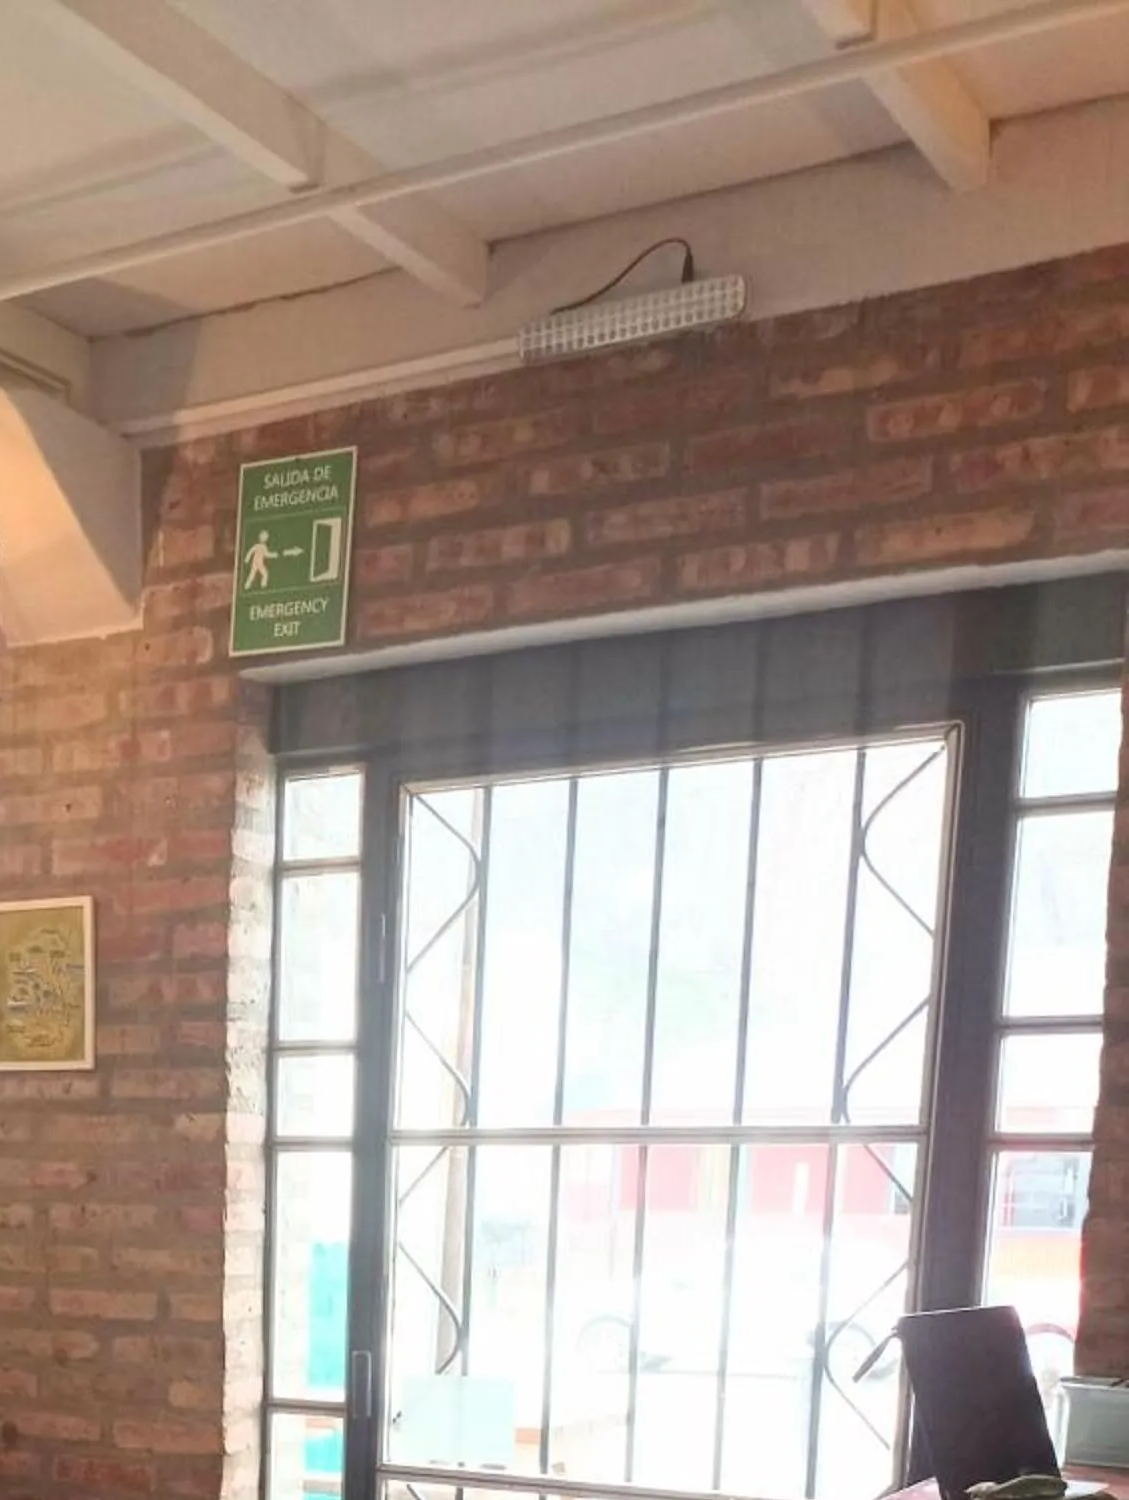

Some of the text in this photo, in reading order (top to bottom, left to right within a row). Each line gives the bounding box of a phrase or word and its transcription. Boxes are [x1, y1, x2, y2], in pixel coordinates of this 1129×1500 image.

[263, 465, 331, 489] SALIDA DE
[254, 485, 339, 511] EMERGENCIA
[249, 598, 328, 620] EMERGENCY
[273, 621, 300, 637] EXIT
